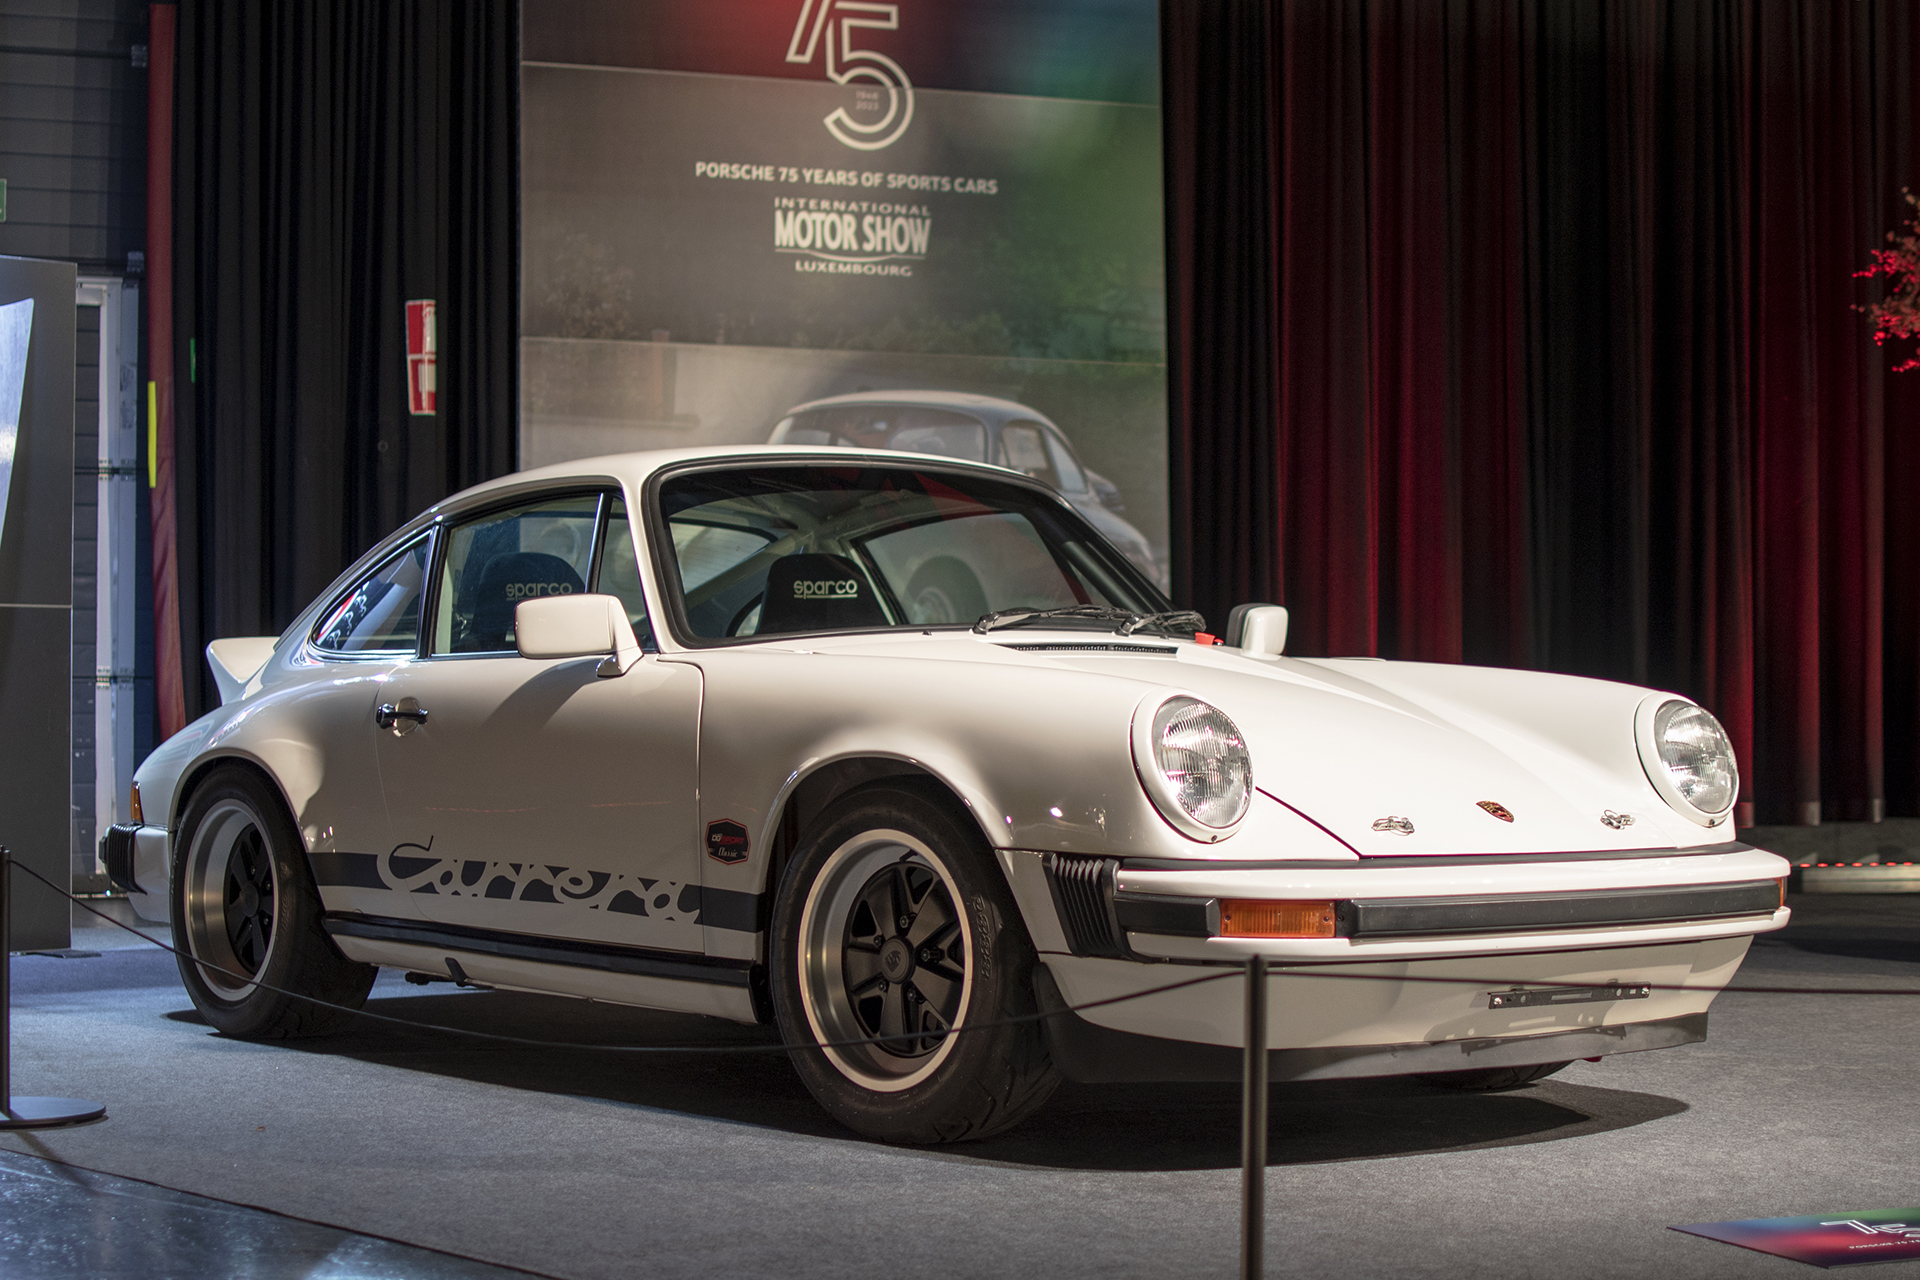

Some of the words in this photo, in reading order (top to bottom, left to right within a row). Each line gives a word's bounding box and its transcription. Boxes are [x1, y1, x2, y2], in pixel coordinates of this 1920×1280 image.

[695, 161, 775, 182] PORSCHE
[778, 167, 799, 183] 75
[801, 168, 858, 187] YEARS
[861, 171, 884, 188] OF
[886, 173, 951, 192] SPORTS
[953, 177, 999, 195] CARS
[774, 197, 931, 216] INTERNATIONAL
[774, 209, 859, 251] MOTOR
[862, 214, 932, 254] SHOW
[795, 260, 913, 277] LUXEMBOURG
[505, 582, 573, 601] sparco
[793, 578, 858, 600] sparco
[376, 835, 700, 924] Carrera
